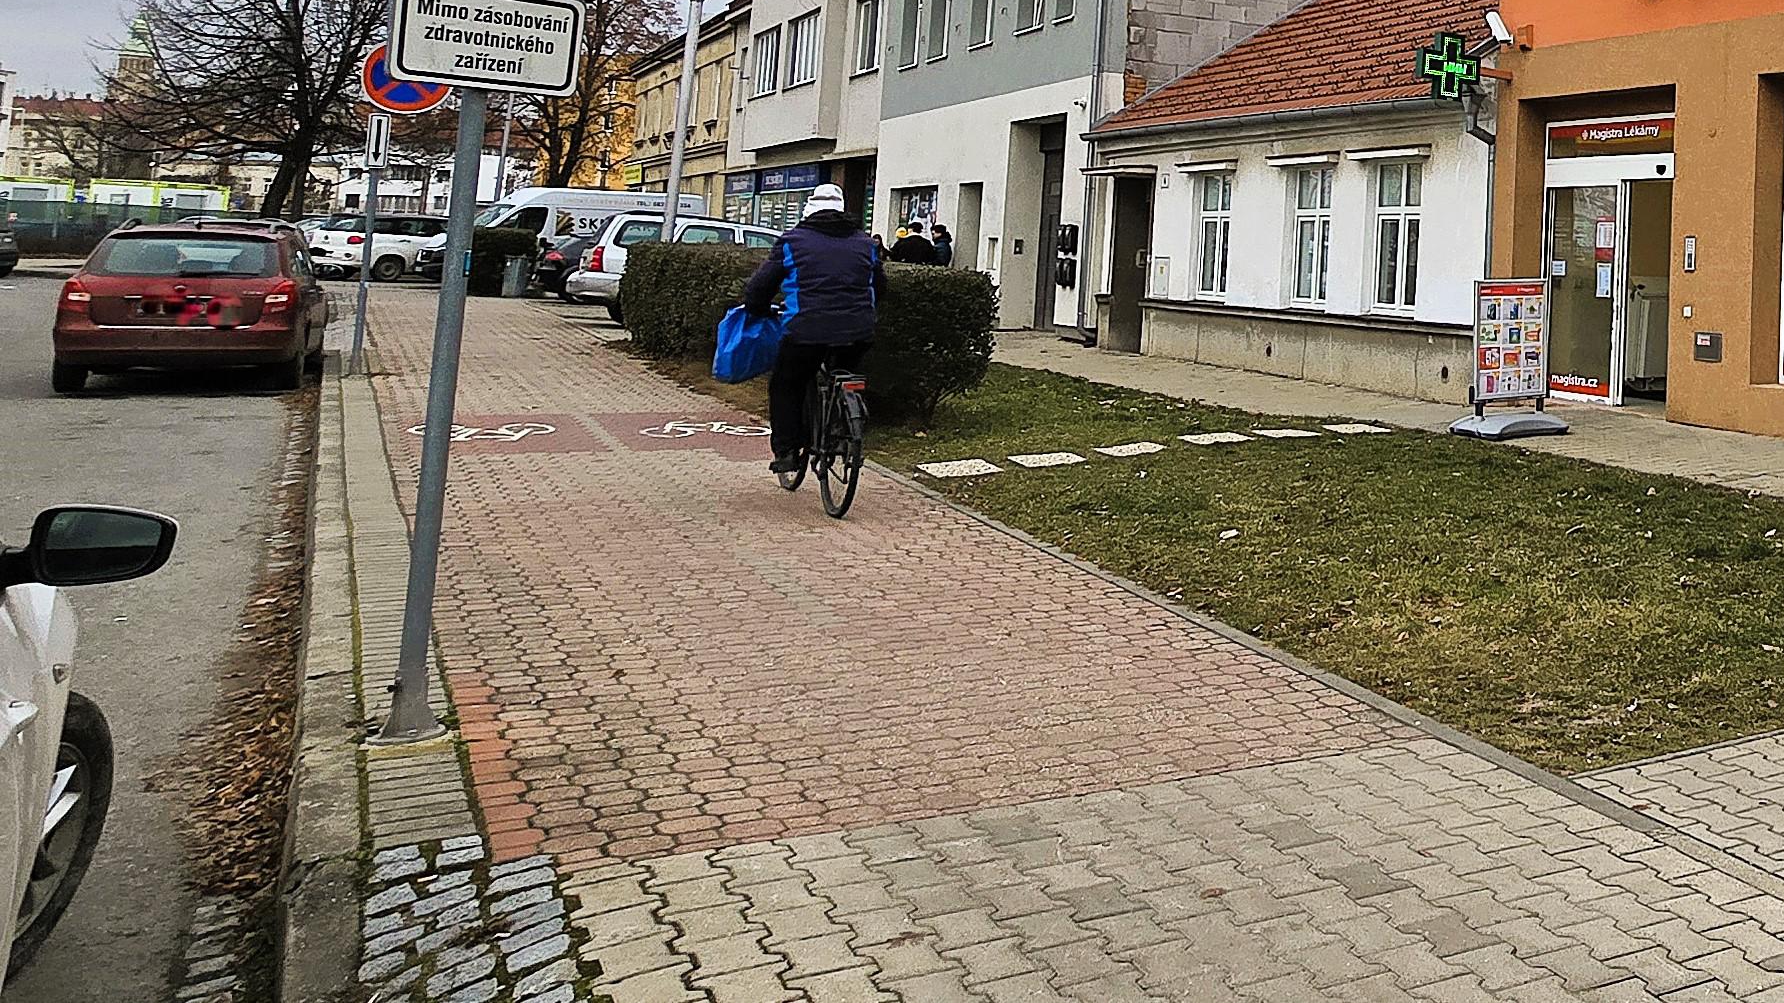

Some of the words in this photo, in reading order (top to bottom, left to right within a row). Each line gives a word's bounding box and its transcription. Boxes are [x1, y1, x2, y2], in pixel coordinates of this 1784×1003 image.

[474, 5, 570, 34] zásobování
[424, 25, 554, 55] zdravotnického
[454, 52, 525, 75] zařízení
[1589, 128, 1623, 141] Magistra
[1624, 125, 1660, 137] Lékárny
[1551, 373, 1598, 388] magistra.cz
